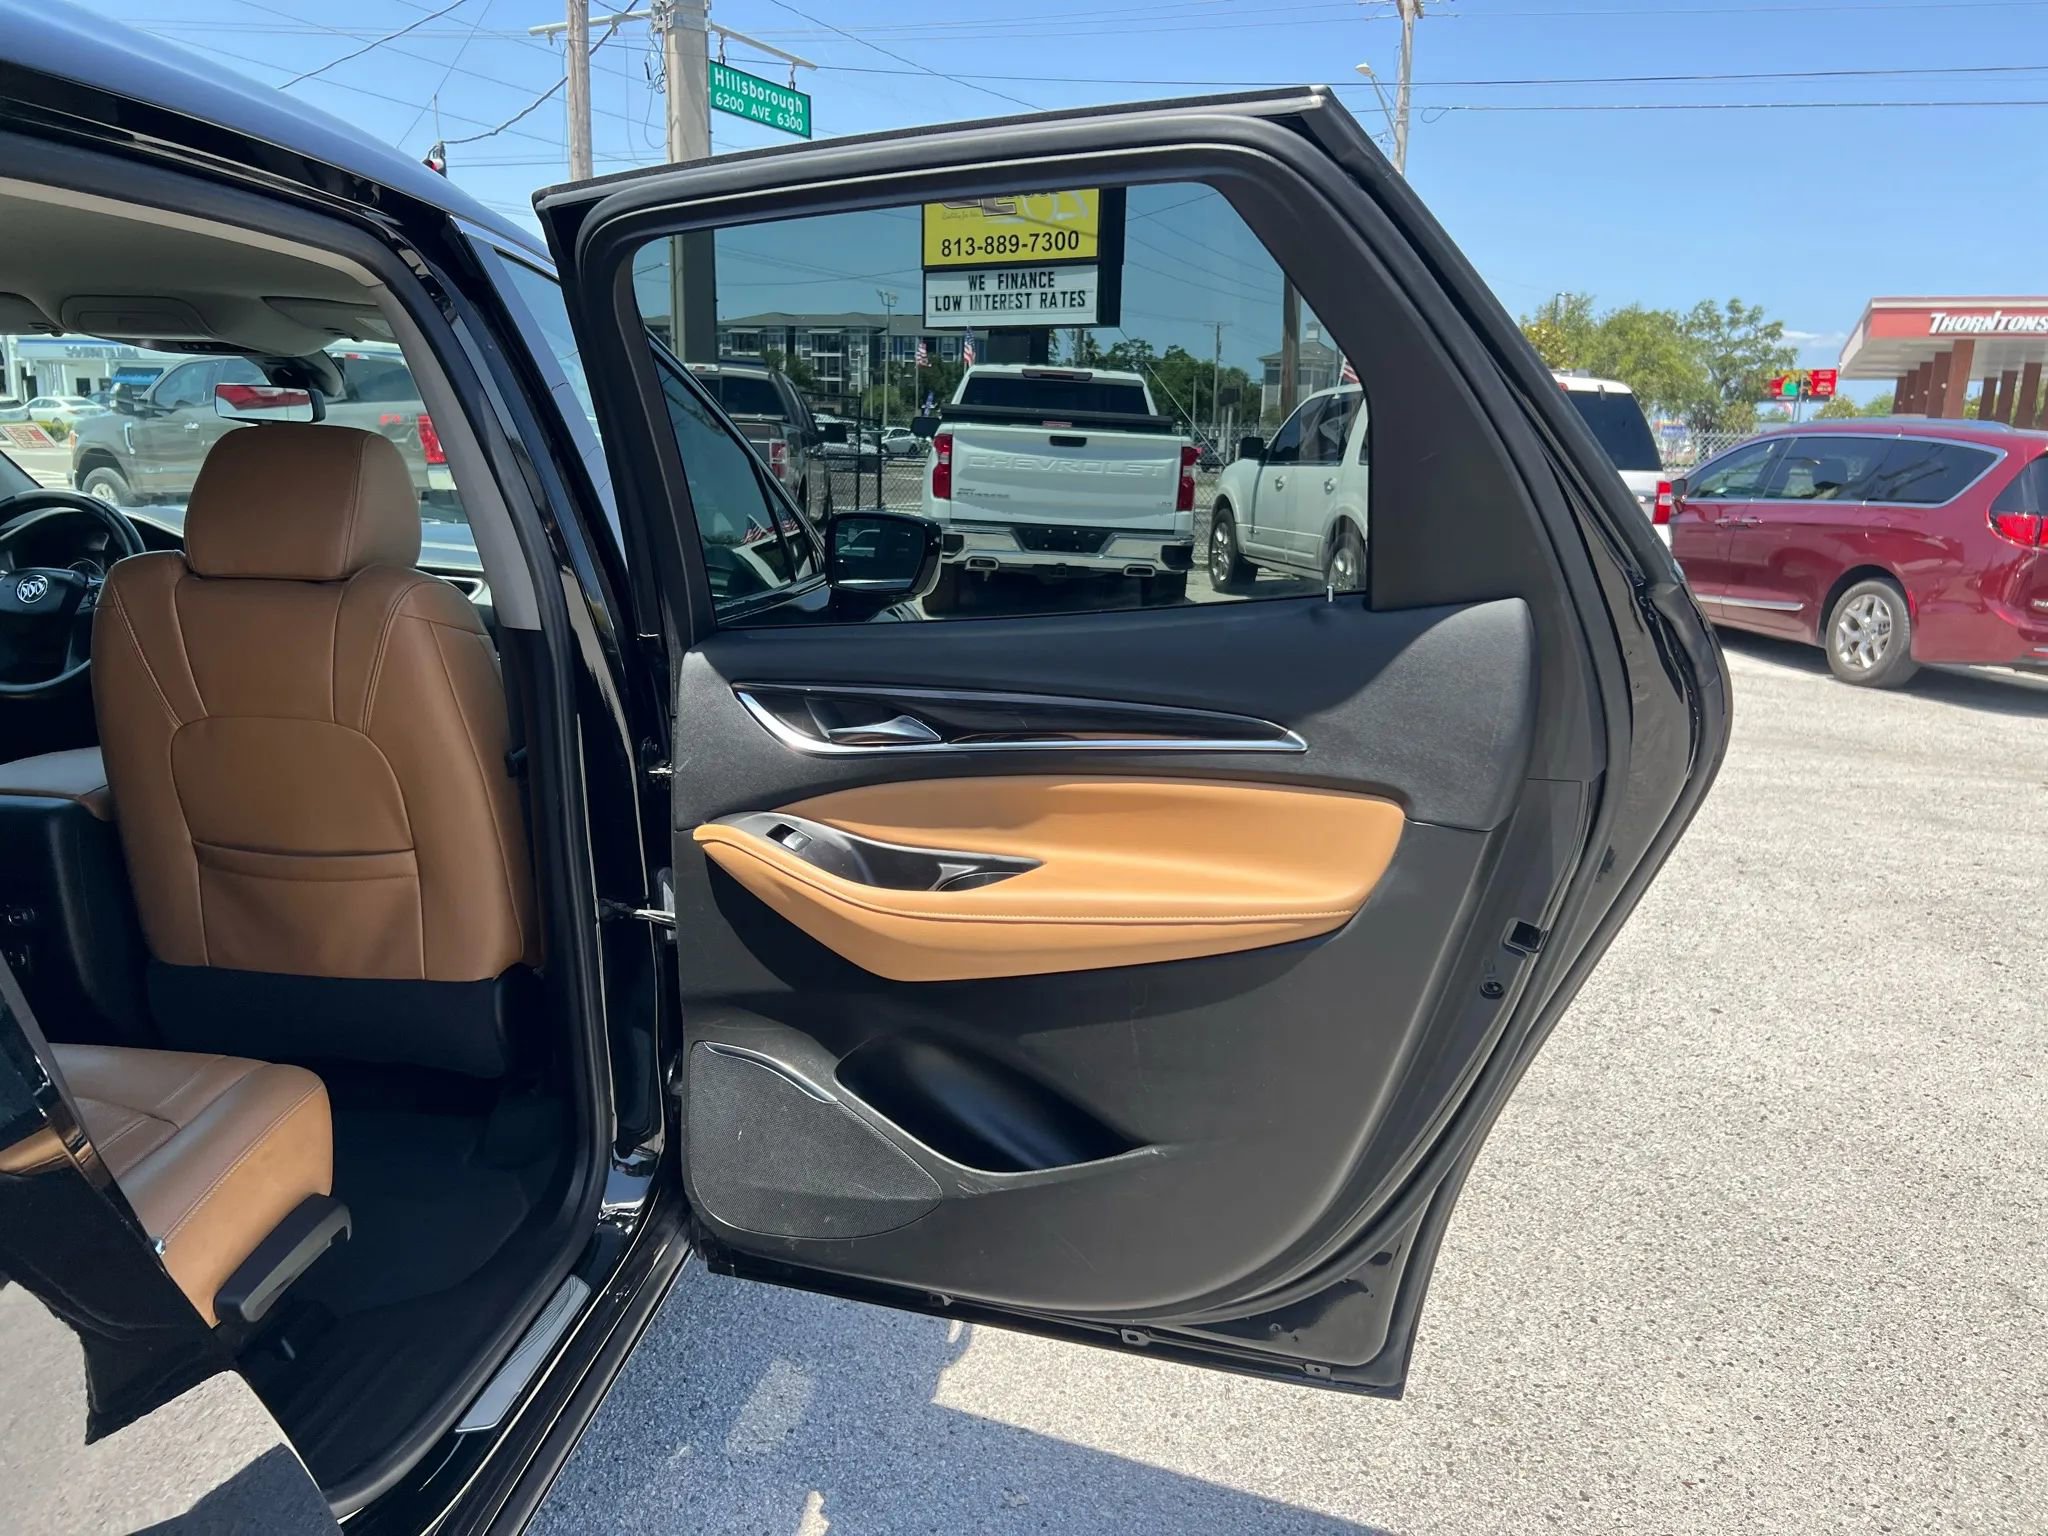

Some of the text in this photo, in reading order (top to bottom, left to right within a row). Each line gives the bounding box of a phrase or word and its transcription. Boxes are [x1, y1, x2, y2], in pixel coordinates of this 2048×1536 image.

[714, 68, 803, 115] Hillsborough
[716, 92, 803, 131] 6200 AVE 6300
[941, 230, 1080, 257] 813-889-7300
[968, 271, 1055, 291] WE FINANCE
[935, 290, 1086, 312] LOW INTEREST RATES
[967, 454, 1166, 477] CHEVROLET
